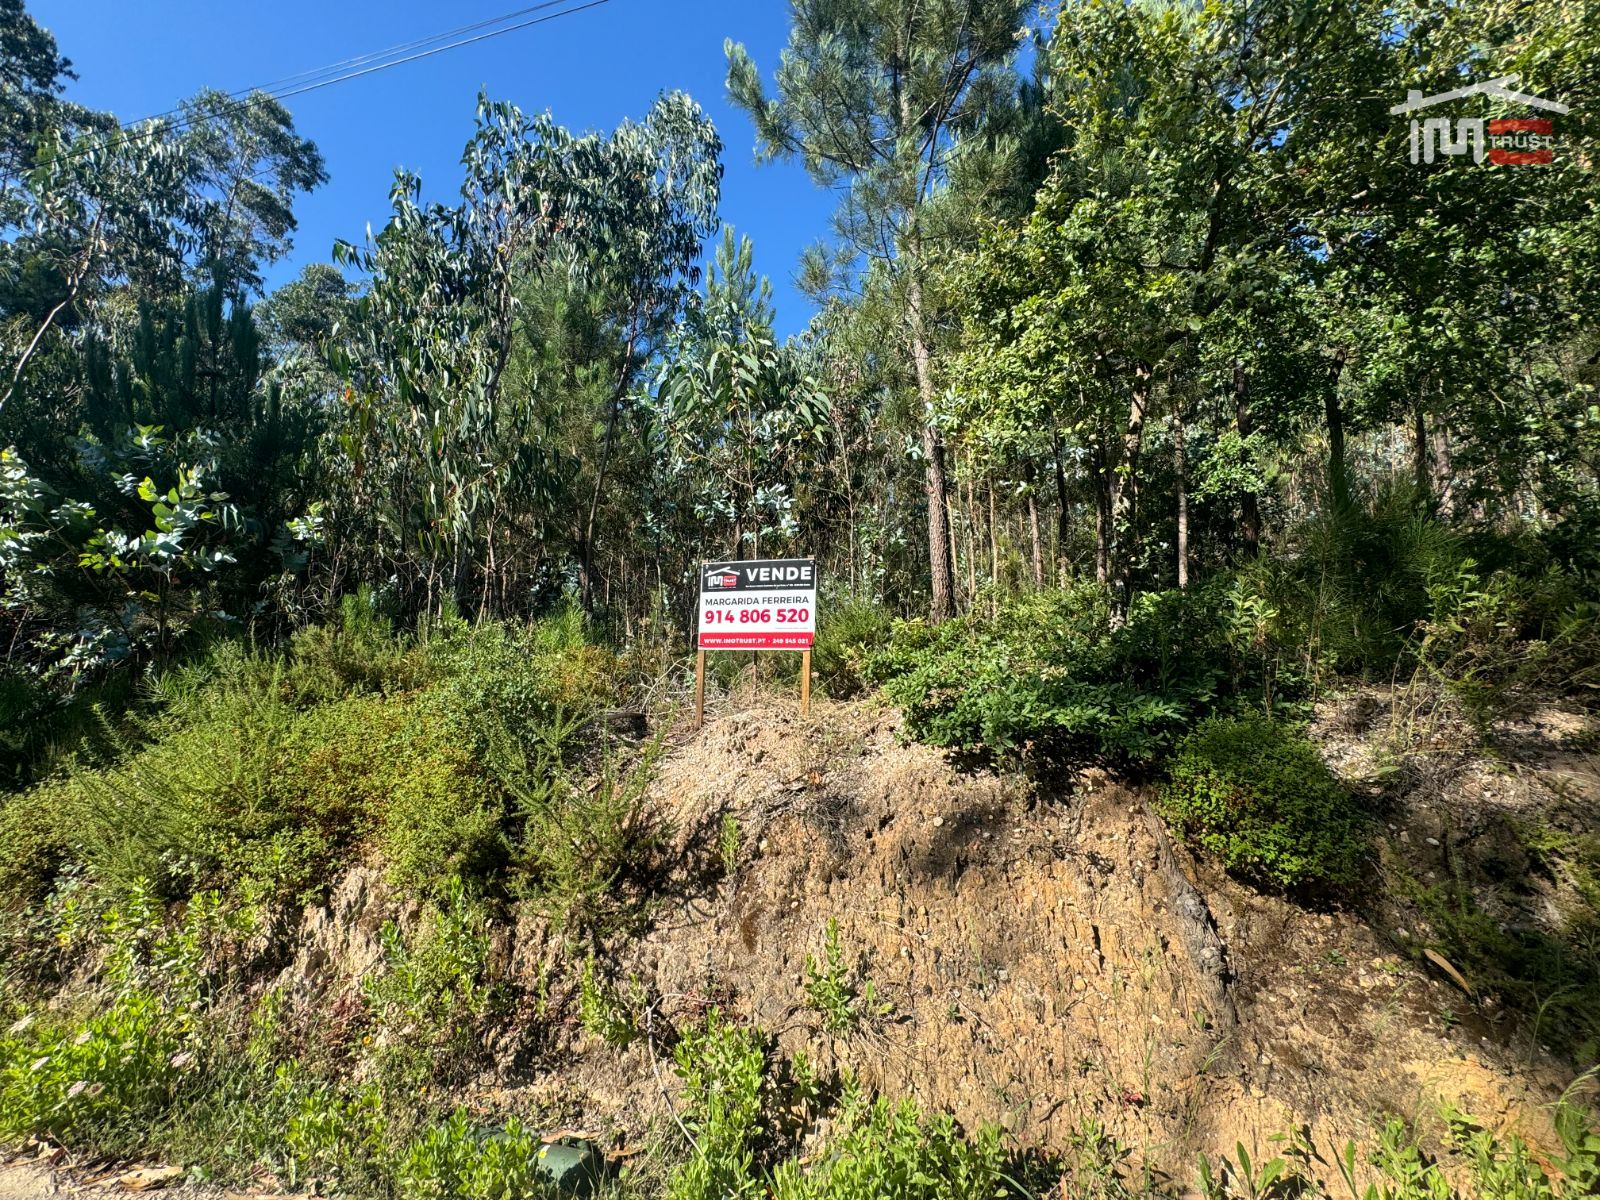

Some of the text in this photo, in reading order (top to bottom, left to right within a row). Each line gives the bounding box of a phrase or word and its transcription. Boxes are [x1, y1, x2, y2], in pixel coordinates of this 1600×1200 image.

[746, 566, 812, 582] VENDE
[705, 596, 809, 606] MARGARIDA FERREIRA
[705, 608, 809, 624] 914 806 520
